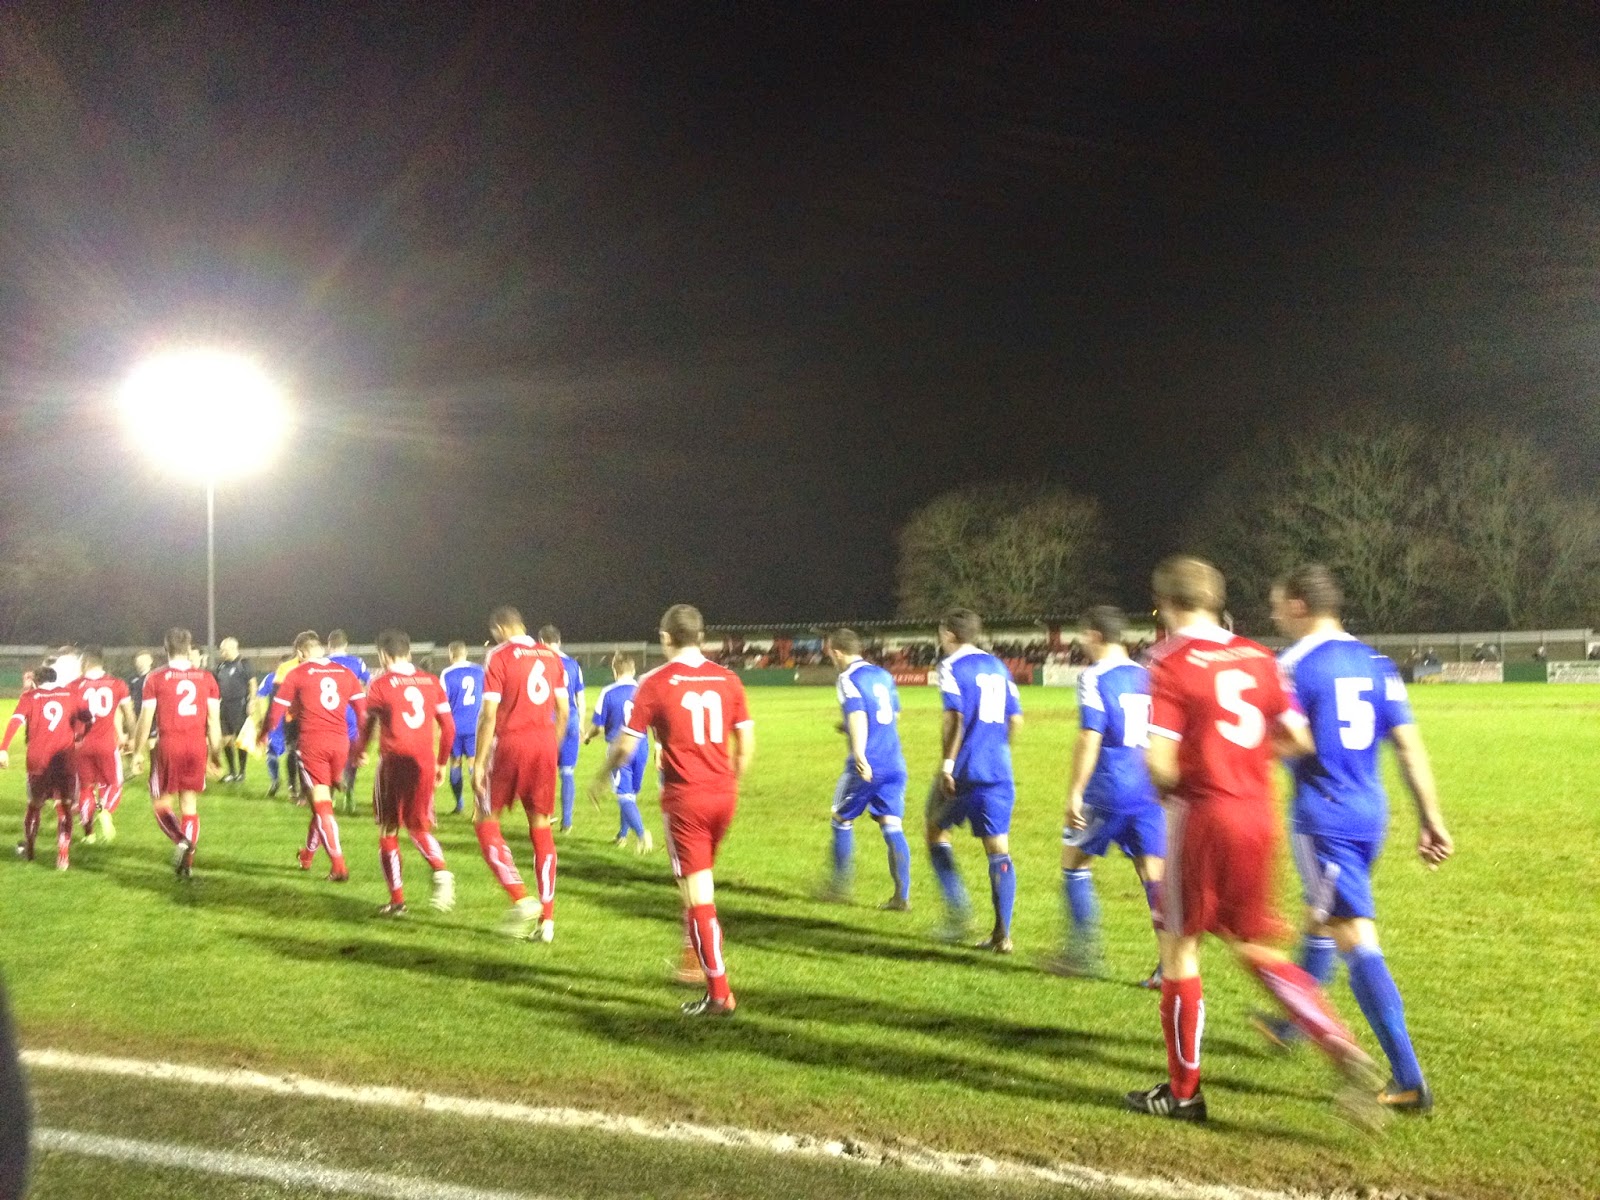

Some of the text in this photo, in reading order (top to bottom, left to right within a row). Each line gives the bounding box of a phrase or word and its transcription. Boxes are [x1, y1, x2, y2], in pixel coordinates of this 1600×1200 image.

[176, 680, 197, 716] 2
[319, 676, 340, 710] 8
[462, 676, 476, 706] 2
[527, 658, 550, 706] 6
[873, 682, 893, 725] 3
[43, 700, 63, 732] 9
[82, 686, 113, 723] 10
[402, 686, 425, 729] 3
[680, 690, 723, 745] 11
[1214, 669, 1266, 749] 5
[1335, 677, 1376, 750] 5
